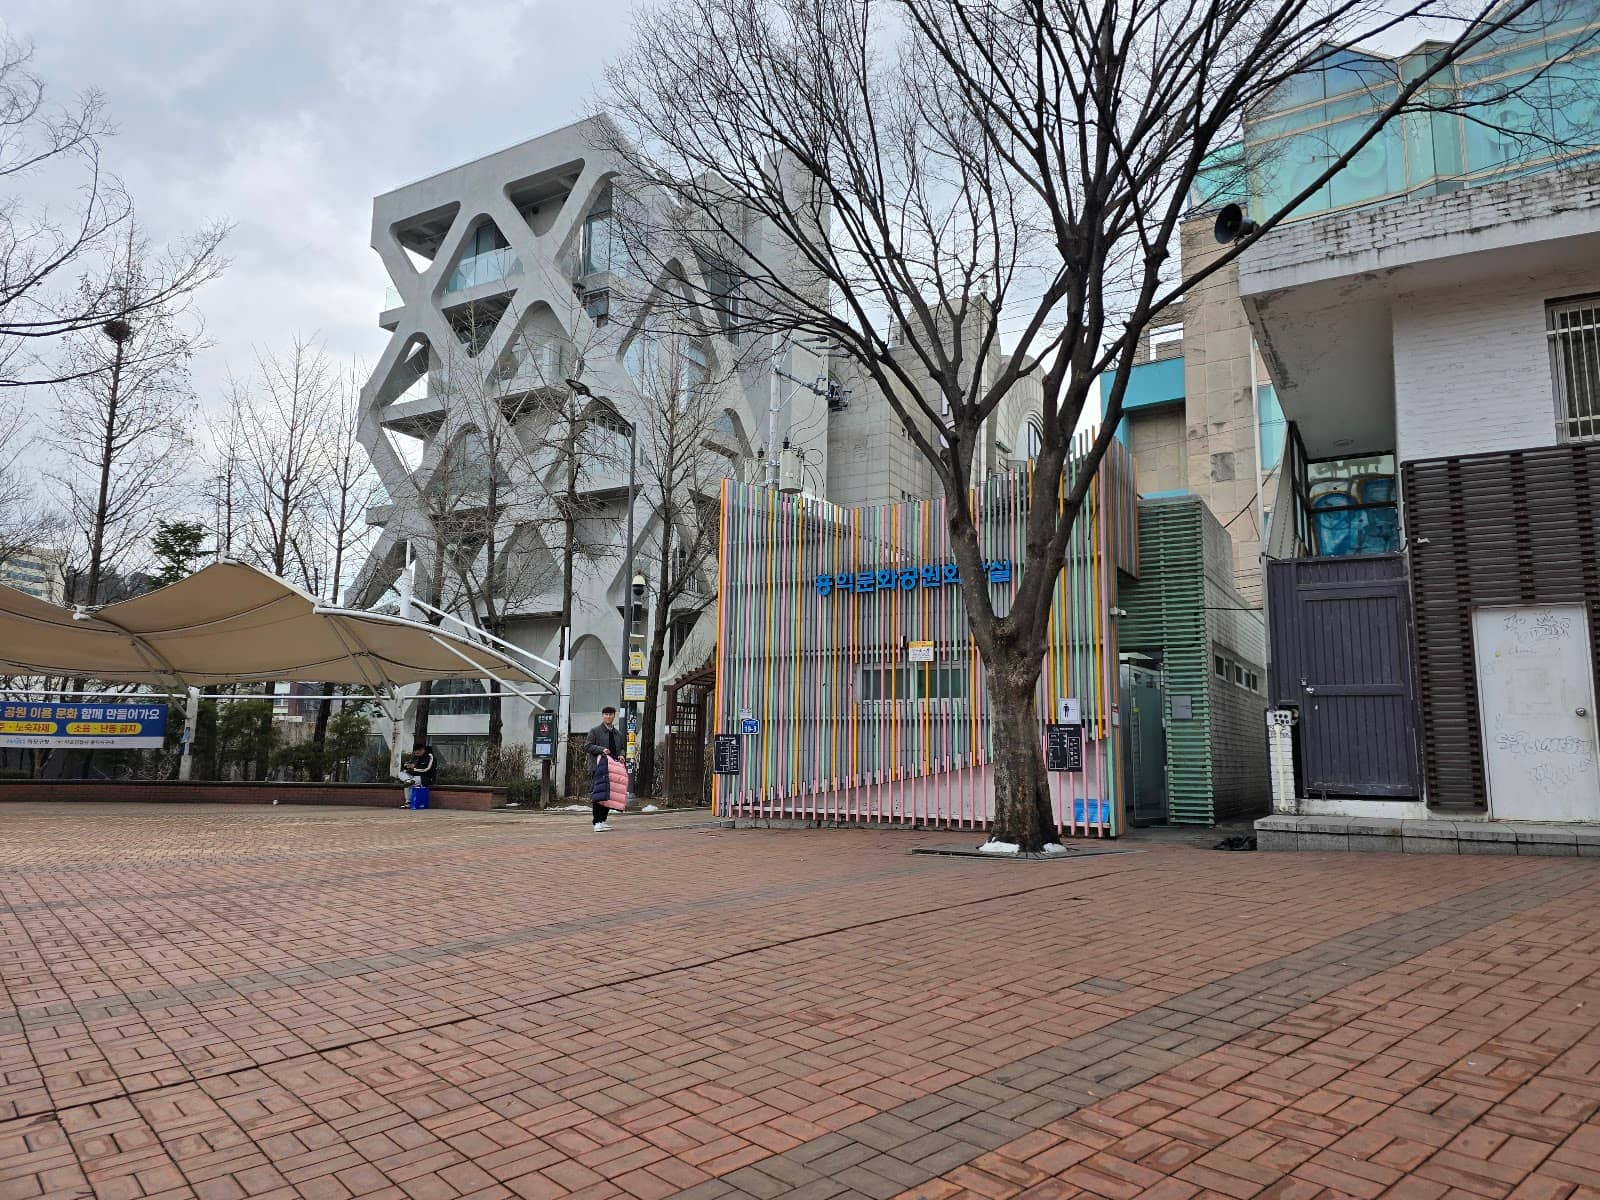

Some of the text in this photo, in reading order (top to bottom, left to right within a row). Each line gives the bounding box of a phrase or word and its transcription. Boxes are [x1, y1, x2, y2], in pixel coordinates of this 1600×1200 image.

[4, 706, 26, 719] 공원
[30, 707, 52, 719] 이용
[55, 707, 78, 720] 문화
[81, 708, 103, 720] 함께
[106, 708, 160, 720] 만들어가요
